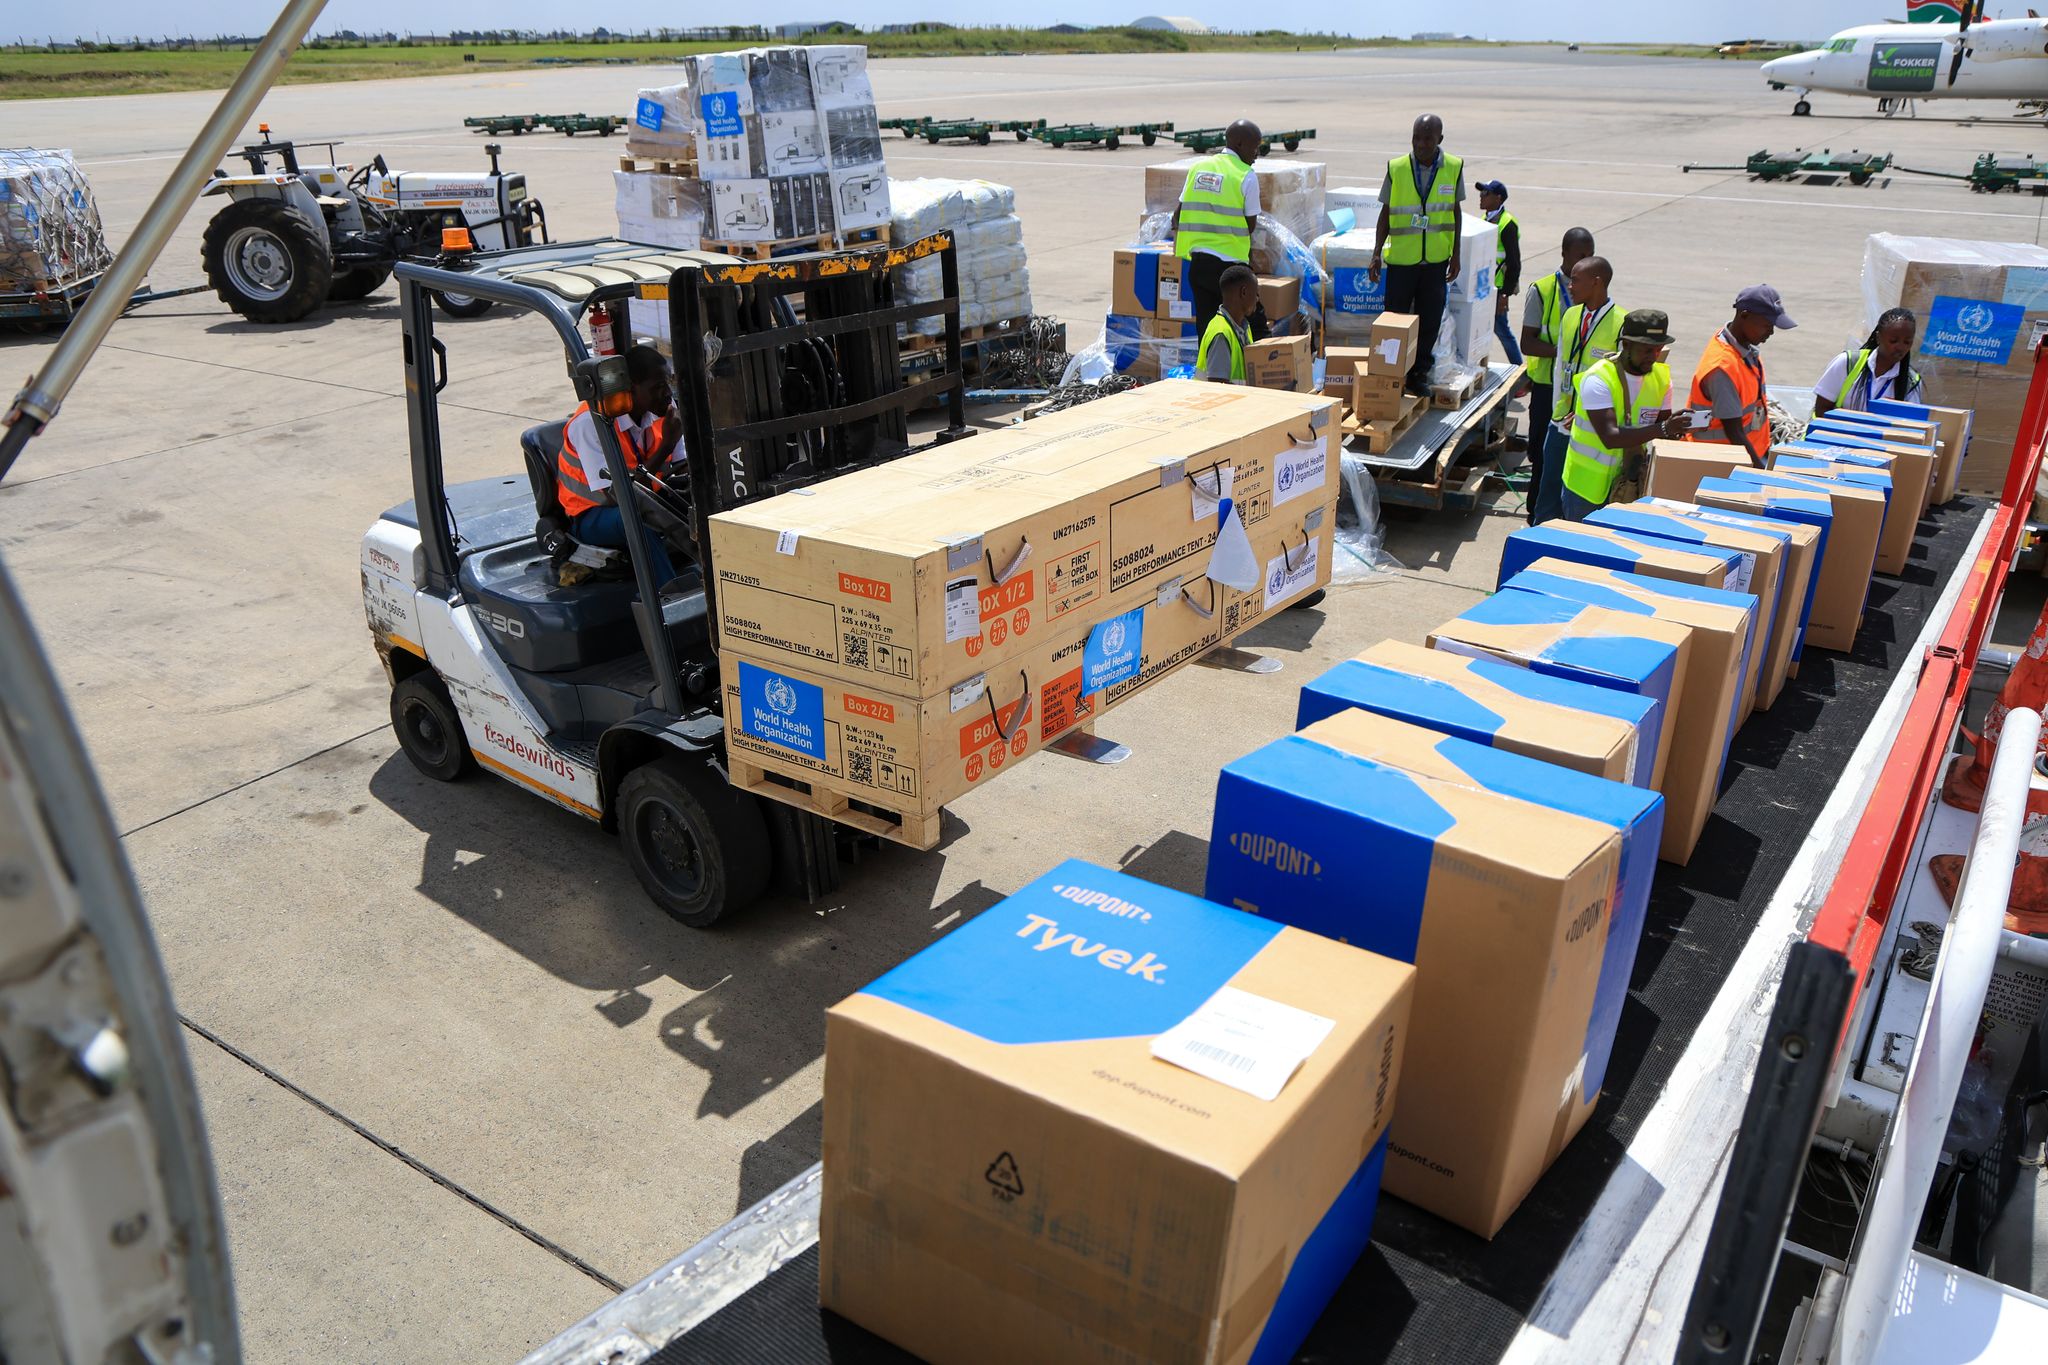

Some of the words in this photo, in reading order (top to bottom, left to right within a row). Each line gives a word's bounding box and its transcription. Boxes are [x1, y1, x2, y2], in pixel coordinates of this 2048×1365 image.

[1893, 58, 1936, 68] FOKKER
[1871, 68, 1934, 78] FREIGHTER
[435, 181, 485, 191] tradewinds
[474, 190, 488, 198] 275
[1343, 302, 1385, 312] Organizatio
[1938, 330, 1968, 344] World
[1969, 334, 2000, 348] Health
[1934, 340, 1998, 358] Organization
[1295, 458, 1310, 472] World
[1310, 453, 1325, 467] Health
[1294, 464, 1324, 483] Organization
[1238, 482, 1260, 496] ALPINTER
[1052, 515, 1096, 540] UN27162575
[1071, 551, 1091, 568] FIRST
[1112, 544, 1154, 572] S5088024
[1112, 572, 1132, 588] HIGH
[1133, 544, 1186, 578] PERFORMANCE
[1187, 537, 1204, 552] TENT
[1207, 531, 1216, 544] 24
[719, 570, 760, 586] UN27162575
[1070, 564, 1088, 577] OPEN
[1071, 576, 1084, 588] THIS
[1086, 569, 1099, 581] BOX
[1286, 564, 1316, 585] Organization
[844, 578, 864, 593] Box
[868, 584, 887, 598] 1/2
[1005, 582, 1026, 602] 1/2
[491, 612, 524, 639] 30
[726, 615, 762, 631] S5088024
[842, 616, 853, 625] 225
[860, 620, 868, 628] 69
[1015, 618, 1028, 632] 3/6
[726, 625, 743, 636] HIGH
[744, 629, 792, 649] PERFORMANCE
[794, 642, 811, 654] TENT
[816, 648, 825, 658] 24
[850, 627, 891, 642] ALPINTER
[992, 628, 1006, 643] 2/6
[968, 638, 982, 654] 1/6
[1051, 636, 1090, 662] UN271625
[1092, 660, 1111, 676] World
[1112, 650, 1133, 668] Health
[1108, 684, 1127, 700] HIGH
[1128, 652, 1180, 689] PERFORMANCE
[1181, 642, 1198, 658] TENT
[1201, 636, 1210, 647] 24
[1090, 664, 1132, 688] Organization
[848, 698, 869, 713] Box
[871, 704, 890, 719] 2/2
[753, 707, 780, 726] World
[782, 717, 812, 738] Health
[754, 720, 813, 750] Organization
[846, 734, 858, 743] 225
[864, 739, 872, 747] 69
[887, 746, 897, 754] cm
[863, 729, 875, 738] 129
[875, 732, 884, 742] kg
[733, 737, 750, 748] HIGH
[751, 740, 799, 761] PERFORMANCE
[800, 756, 817, 768] TENT
[821, 763, 831, 772] 24
[854, 745, 895, 761] ALPINTER
[1013, 739, 1026, 752] 6/6
[991, 752, 1004, 765] 5/6
[968, 764, 980, 778] 4/6
[1240, 832, 1313, 876] DUPONT
[1060, 886, 1144, 919] DUPONT
[1016, 913, 1168, 982] Tyvek
[1092, 1070, 1212, 1119] dpp.dupont.com
